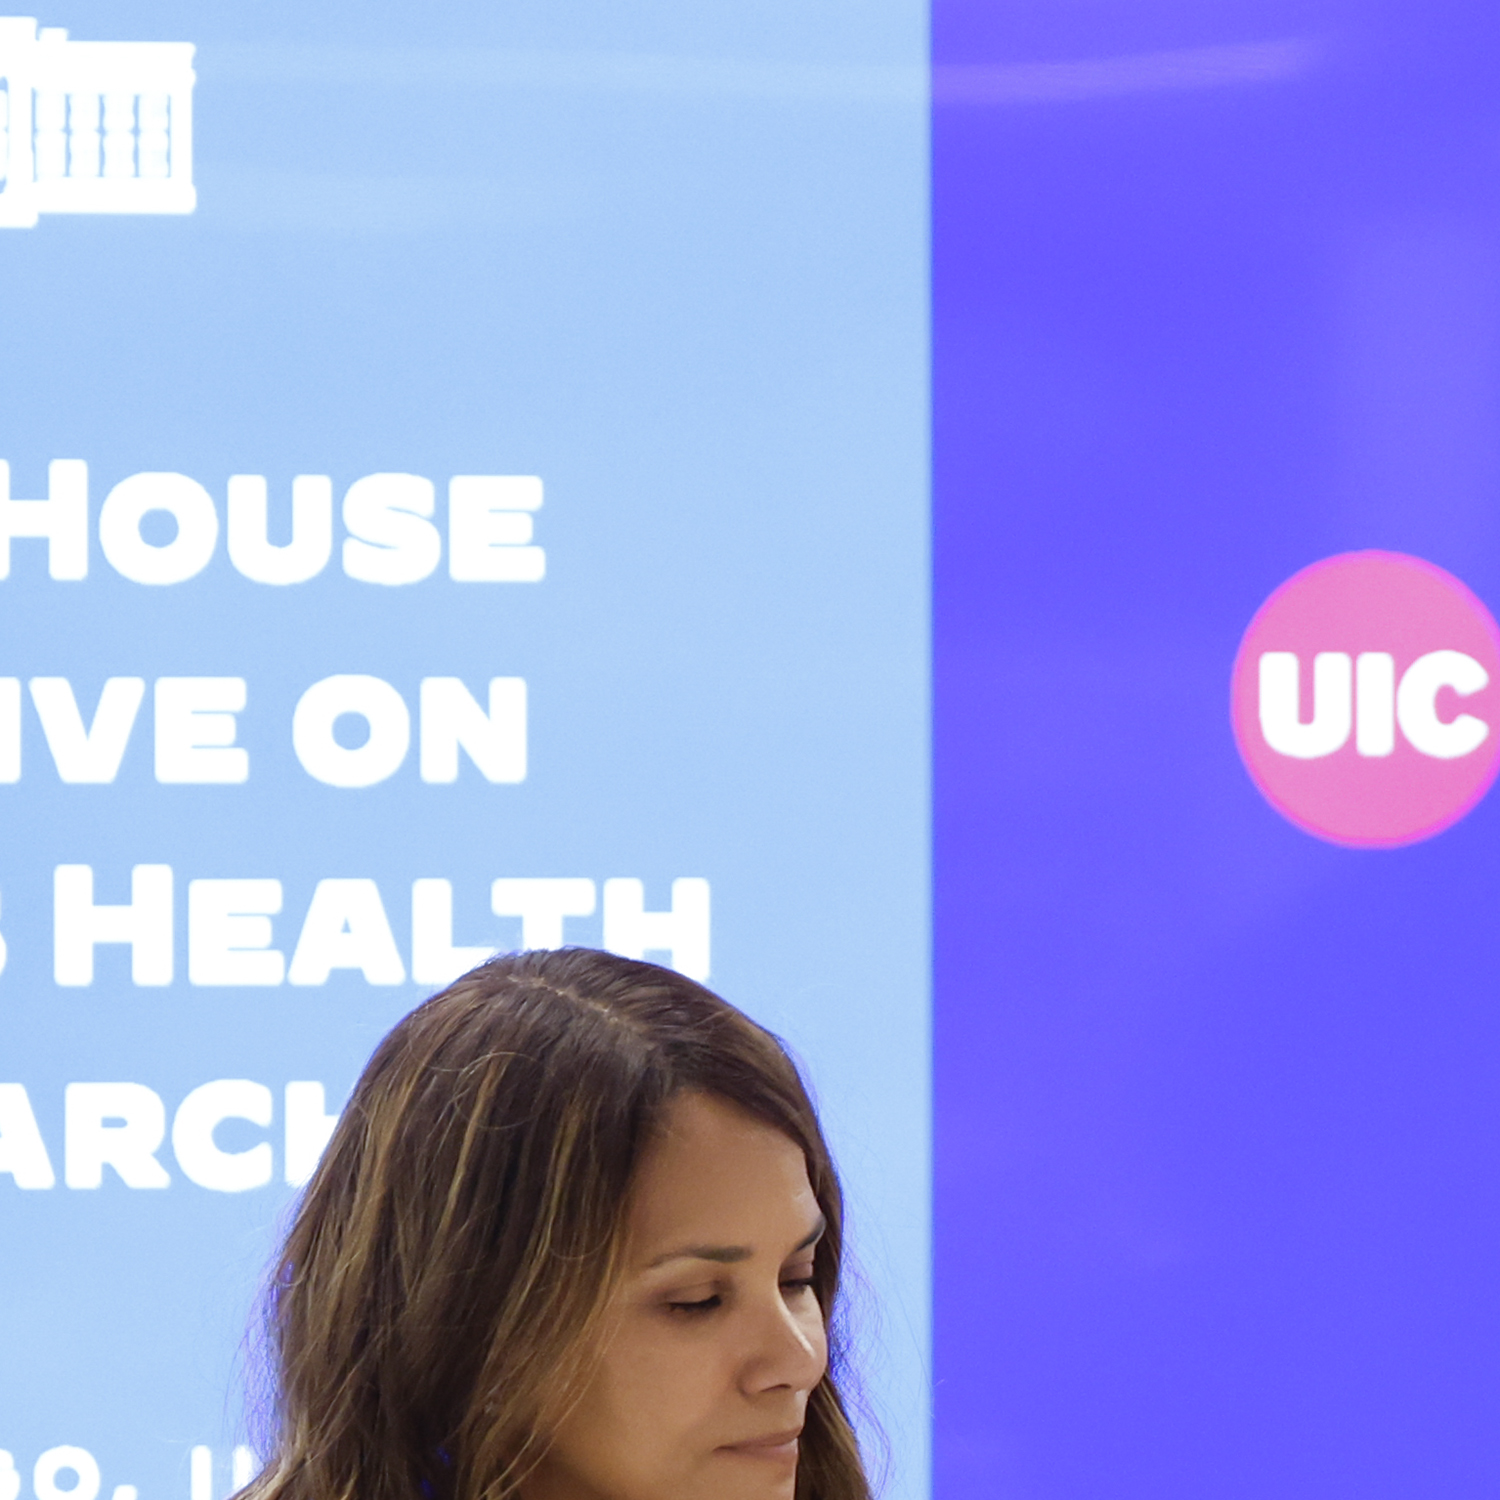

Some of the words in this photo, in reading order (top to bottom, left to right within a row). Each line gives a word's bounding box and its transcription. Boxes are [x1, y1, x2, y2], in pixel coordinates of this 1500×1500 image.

[0, 458, 546, 586] HOUSE
[292, 674, 528, 788] ON
[1258, 649, 1489, 759] UIC
[54, 864, 711, 987] HEALTH
